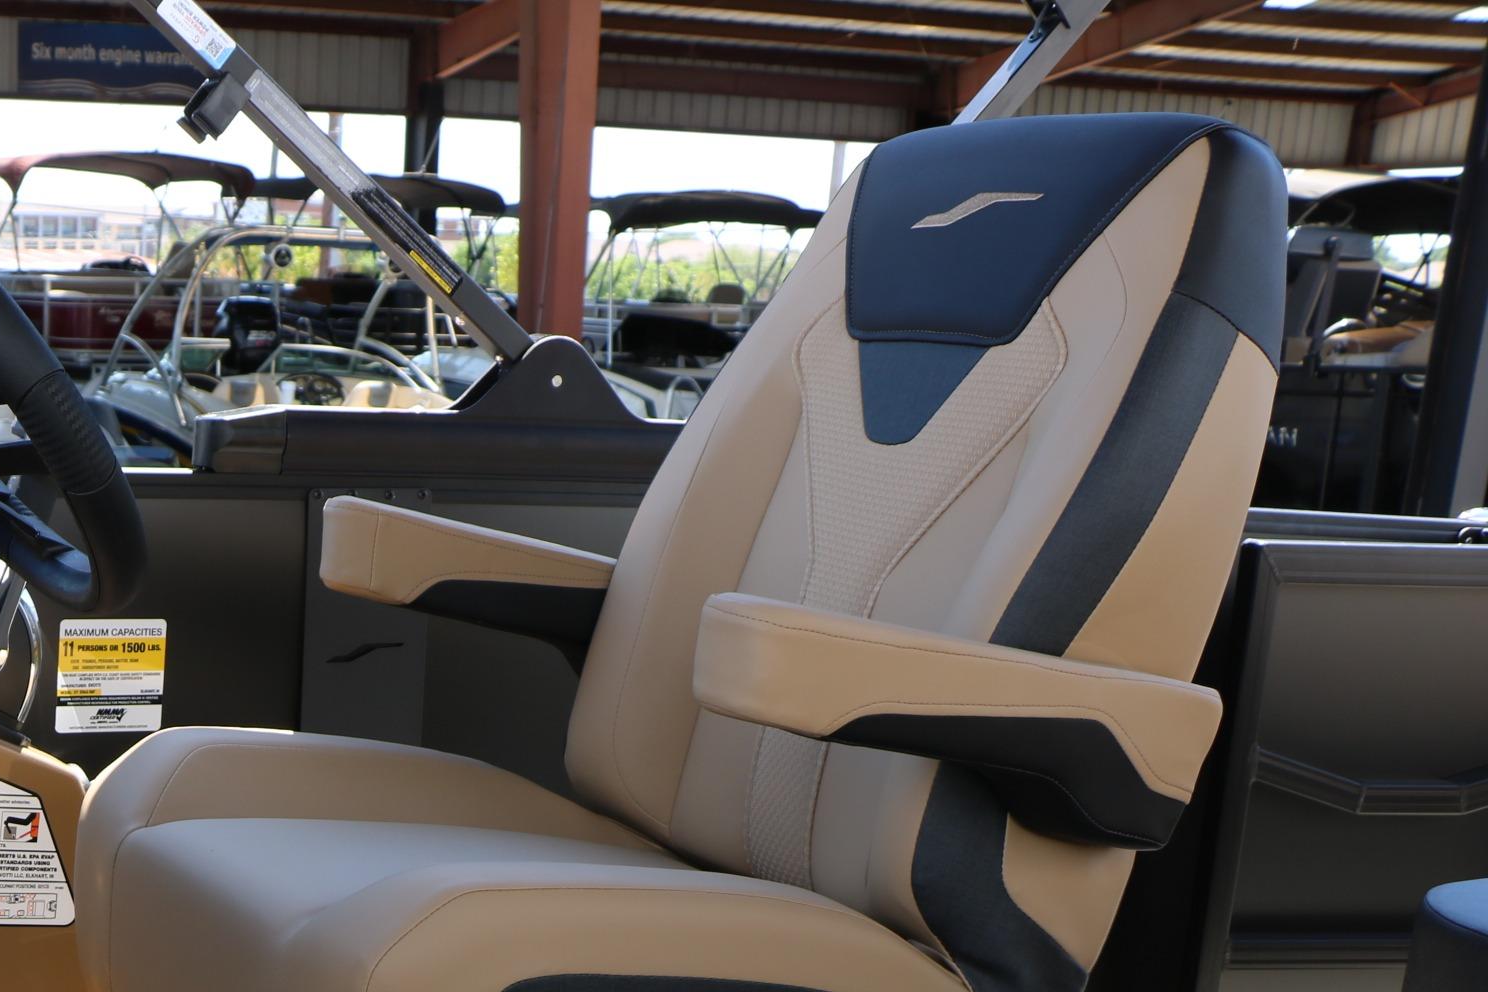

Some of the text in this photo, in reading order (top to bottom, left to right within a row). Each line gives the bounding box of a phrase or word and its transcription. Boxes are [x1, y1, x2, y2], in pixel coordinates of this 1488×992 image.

[32, 42, 52, 60] Six
[54, 43, 96, 61] month
[99, 46, 142, 65] engine
[64, 628, 162, 637] MAXIMUM CAPACITIES
[63, 641, 74, 657] 11
[122, 642, 146, 653] 1500
